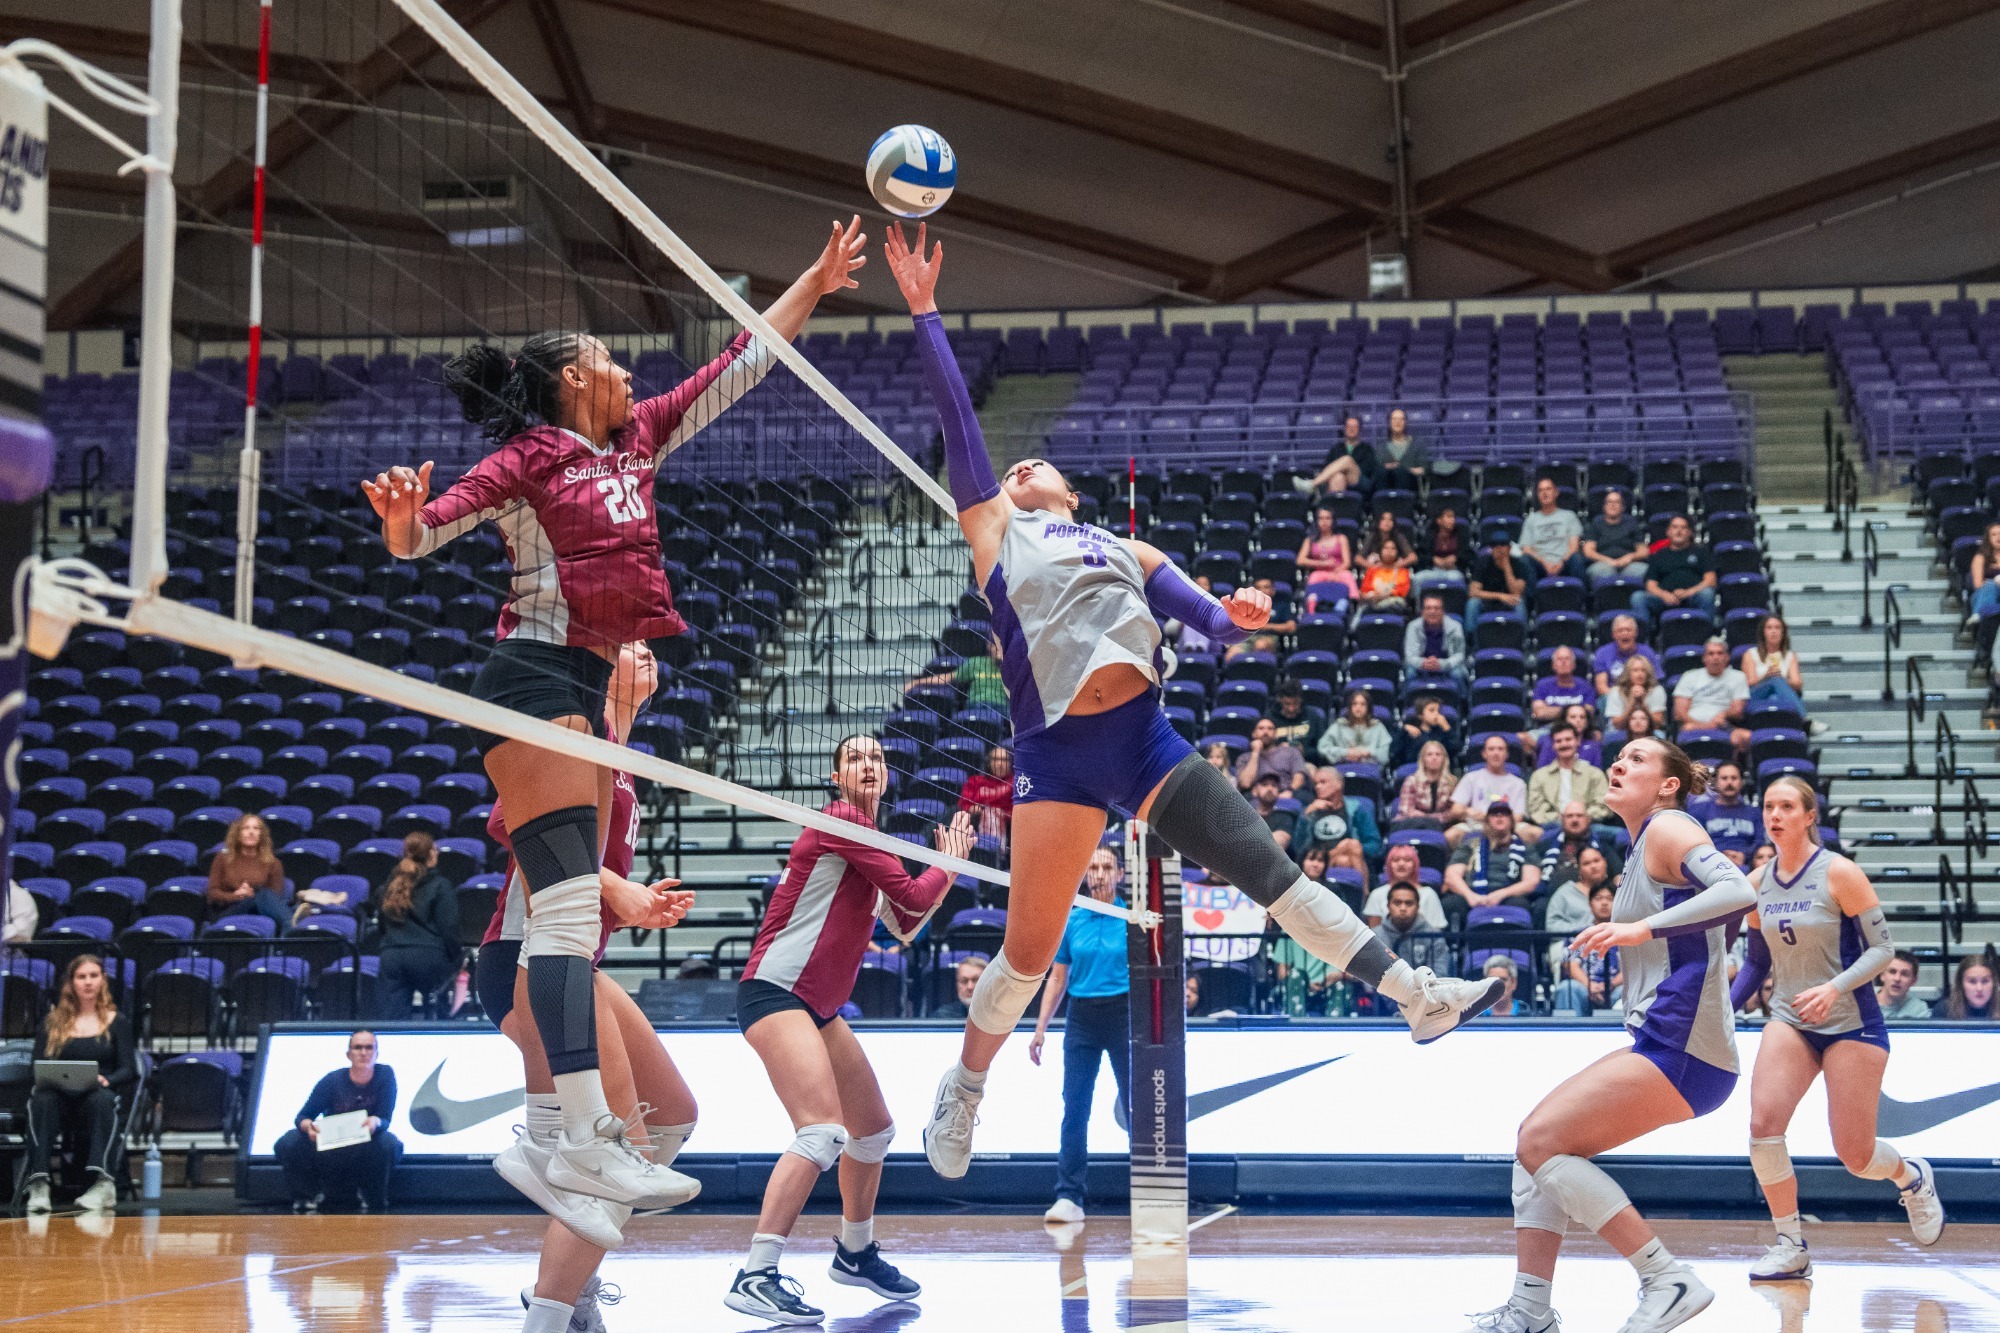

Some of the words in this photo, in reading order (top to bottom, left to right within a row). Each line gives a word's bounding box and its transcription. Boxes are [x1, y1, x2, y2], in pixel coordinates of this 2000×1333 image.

[563, 461, 612, 484] Santa
[617, 451, 654, 473] Clara
[596, 474, 648, 525] 20
[1077, 540, 1108, 569] 3
[1763, 901, 1812, 916] PORTLAND
[1778, 918, 1797, 945] 5
[1152, 1069, 1168, 1114] sports
